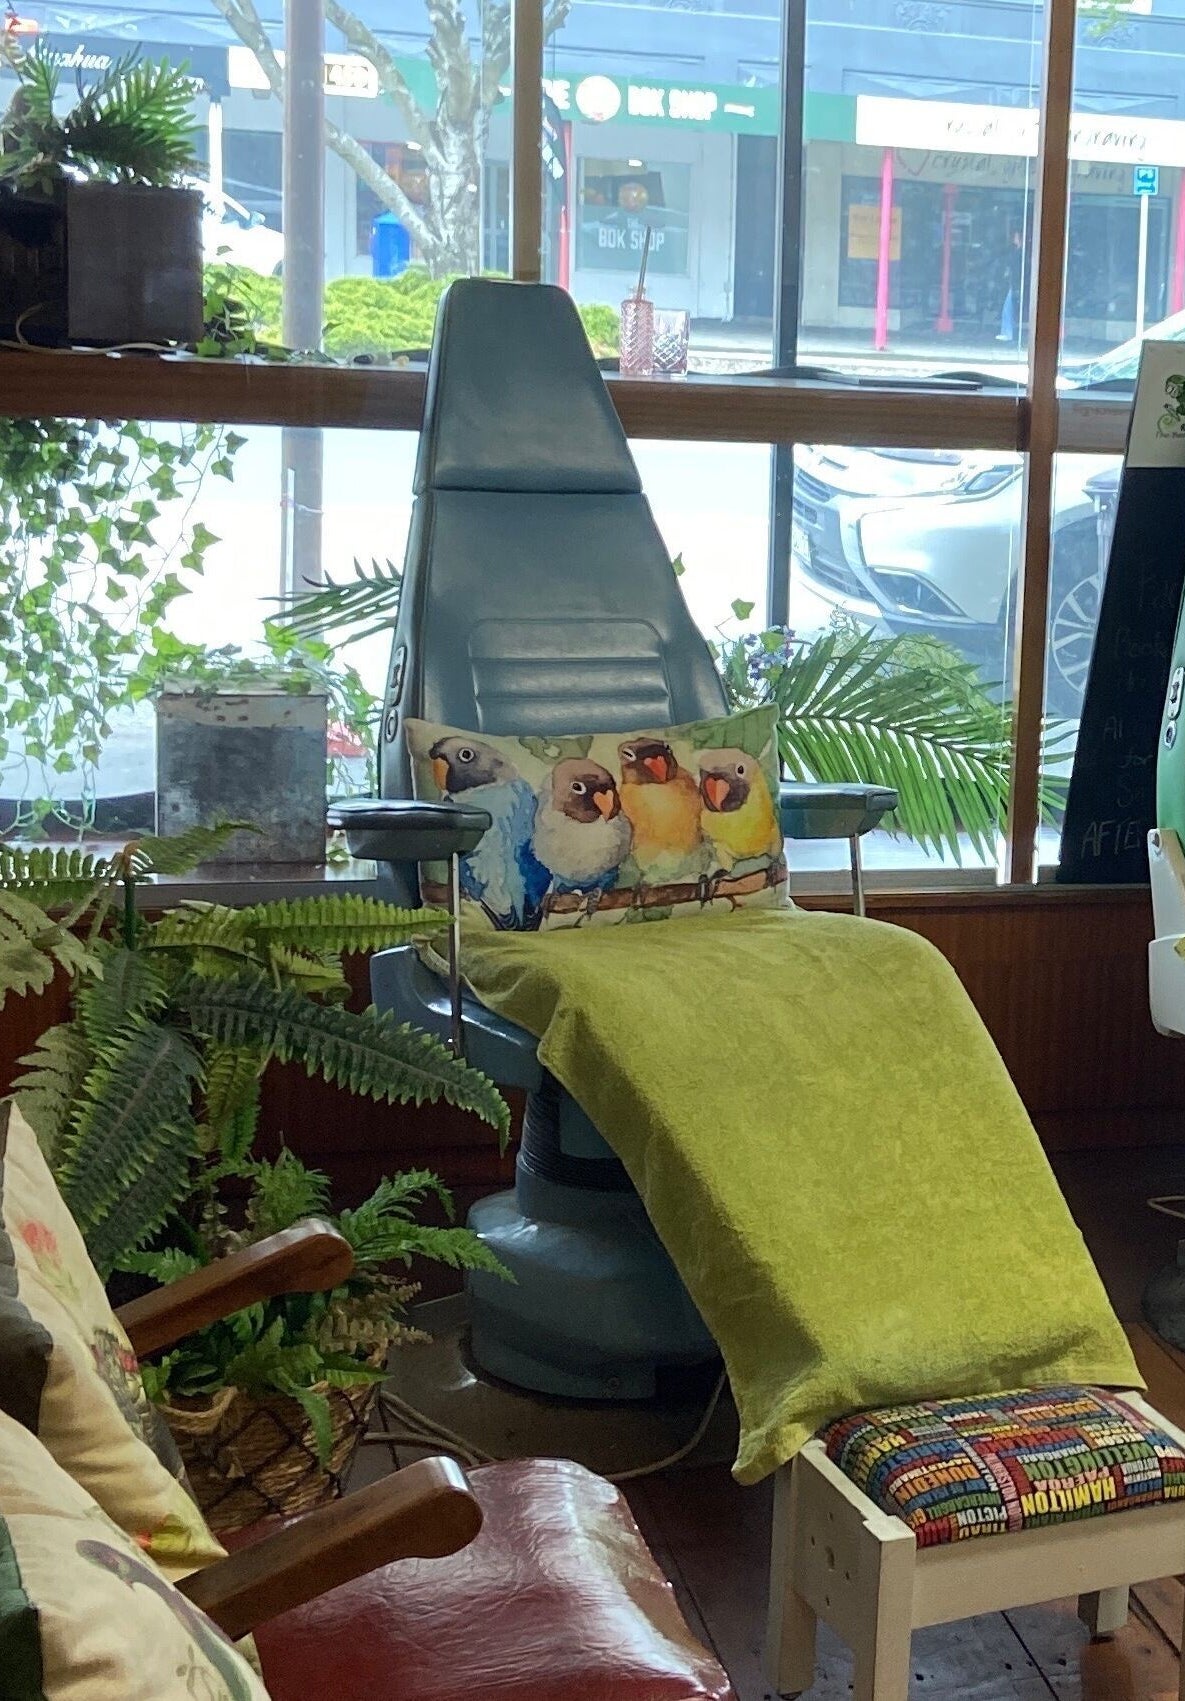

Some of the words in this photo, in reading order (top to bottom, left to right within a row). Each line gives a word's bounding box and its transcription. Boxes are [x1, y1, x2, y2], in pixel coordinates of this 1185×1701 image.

[598, 227, 627, 249] BOK
[630, 230, 665, 252] SHOP
[1023, 1441, 1157, 1482] WELLINGTON
[894, 1463, 981, 1505] DUNEDIN
[1033, 1466, 1110, 1492] PAEROA
[1020, 1476, 1117, 1517] HAMILTON
[957, 1505, 1008, 1527] PICTON
